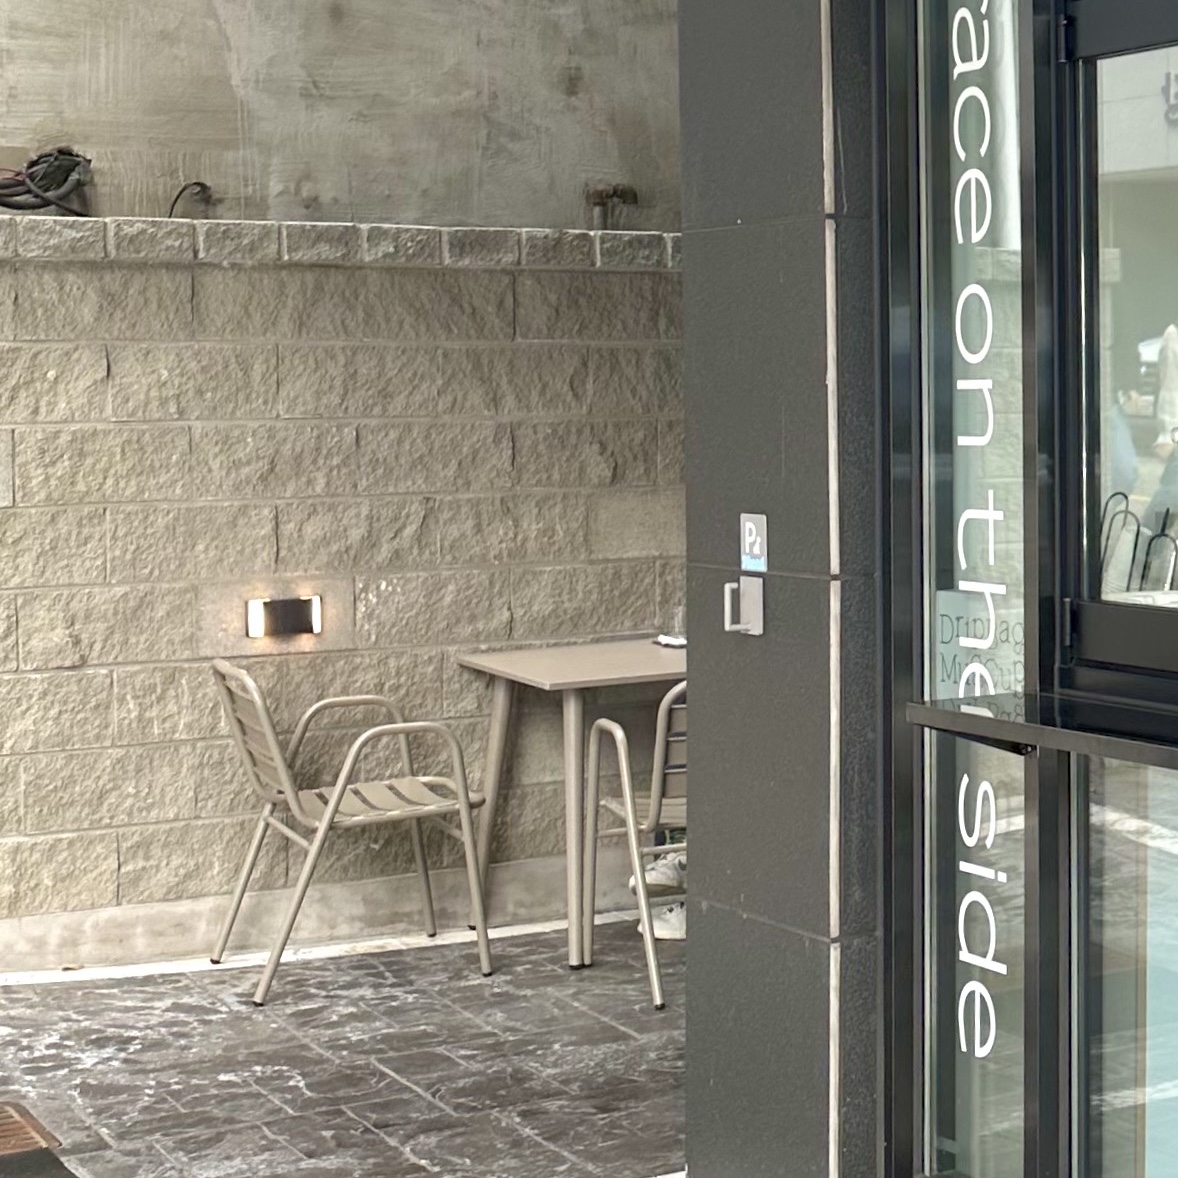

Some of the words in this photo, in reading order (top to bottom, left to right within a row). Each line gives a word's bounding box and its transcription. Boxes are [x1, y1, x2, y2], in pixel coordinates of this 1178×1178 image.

[952, 0, 991, 244] ace
[955, 283, 994, 446] on
[958, 773, 1007, 1058] side
